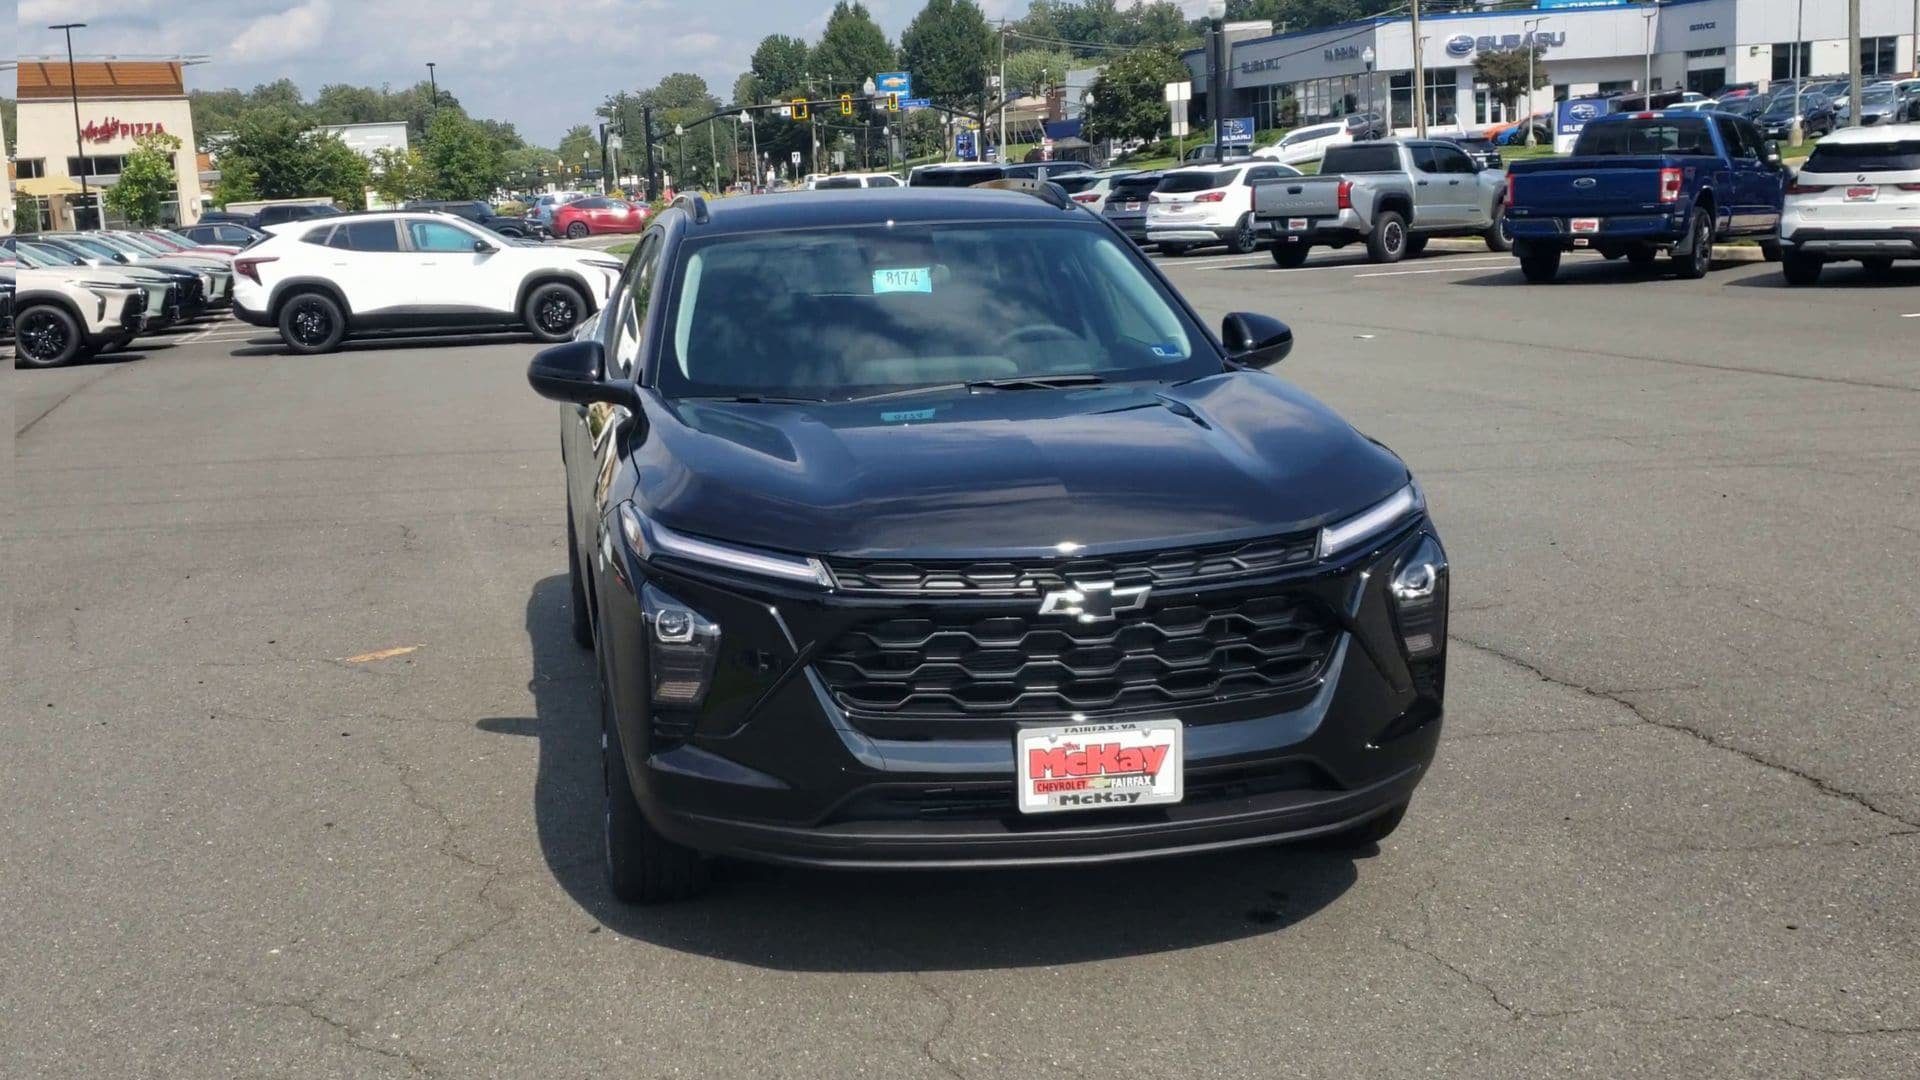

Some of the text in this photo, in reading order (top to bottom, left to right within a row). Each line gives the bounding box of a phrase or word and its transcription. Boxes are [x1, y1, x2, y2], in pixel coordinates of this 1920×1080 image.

[1476, 31, 1566, 51] SUBARU
[120, 123, 164, 140] PIZZA
[1562, 124, 1584, 132] SUB
[1029, 742, 1170, 779] McKay
[1036, 776, 1151, 793] CHEVROLET FAIRFAX
[1059, 791, 1141, 806] McKay
